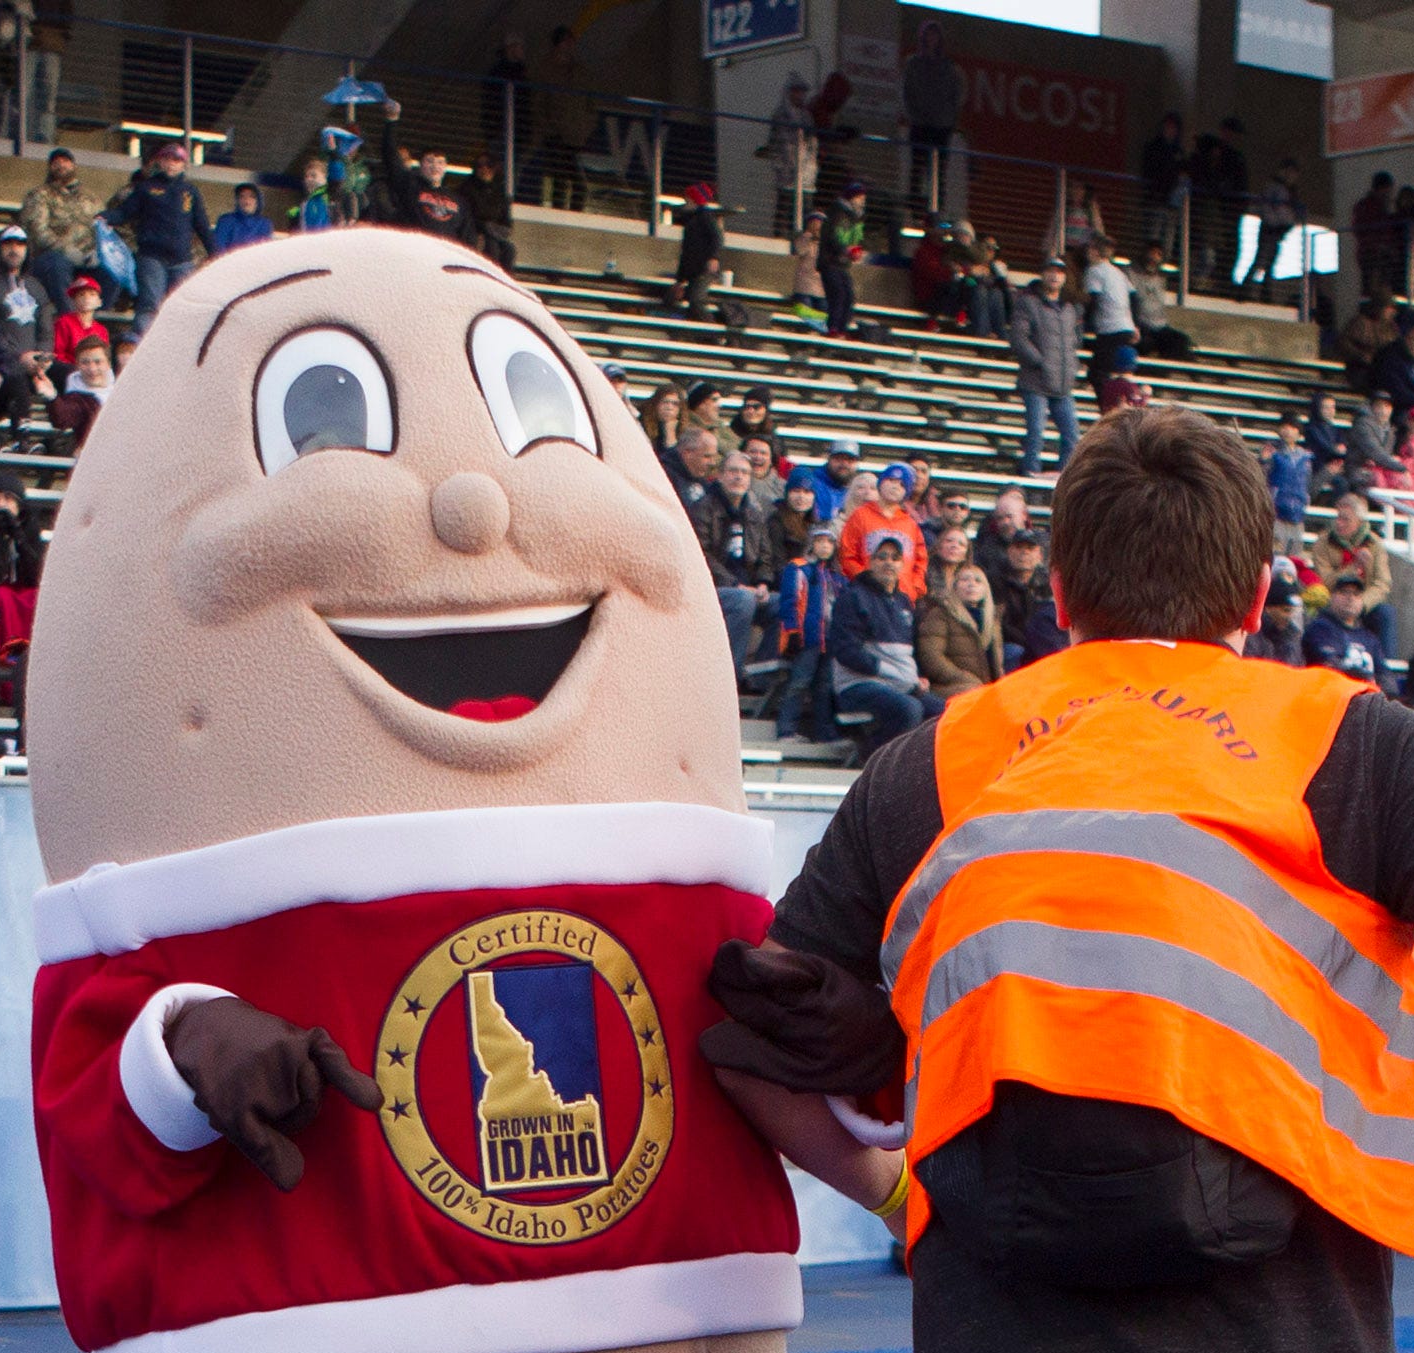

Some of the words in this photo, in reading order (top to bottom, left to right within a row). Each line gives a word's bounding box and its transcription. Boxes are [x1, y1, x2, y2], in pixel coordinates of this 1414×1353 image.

[712, 1, 752, 40] 122
[449, 914, 598, 968] Certified
[487, 1115, 553, 1140] GROWN
[557, 1113, 575, 1133] IN
[487, 1130, 601, 1184] IDAHO
[413, 1156, 480, 1215] 100%
[482, 1203, 567, 1240] Idaho
[573, 1138, 661, 1233] Potatoes
